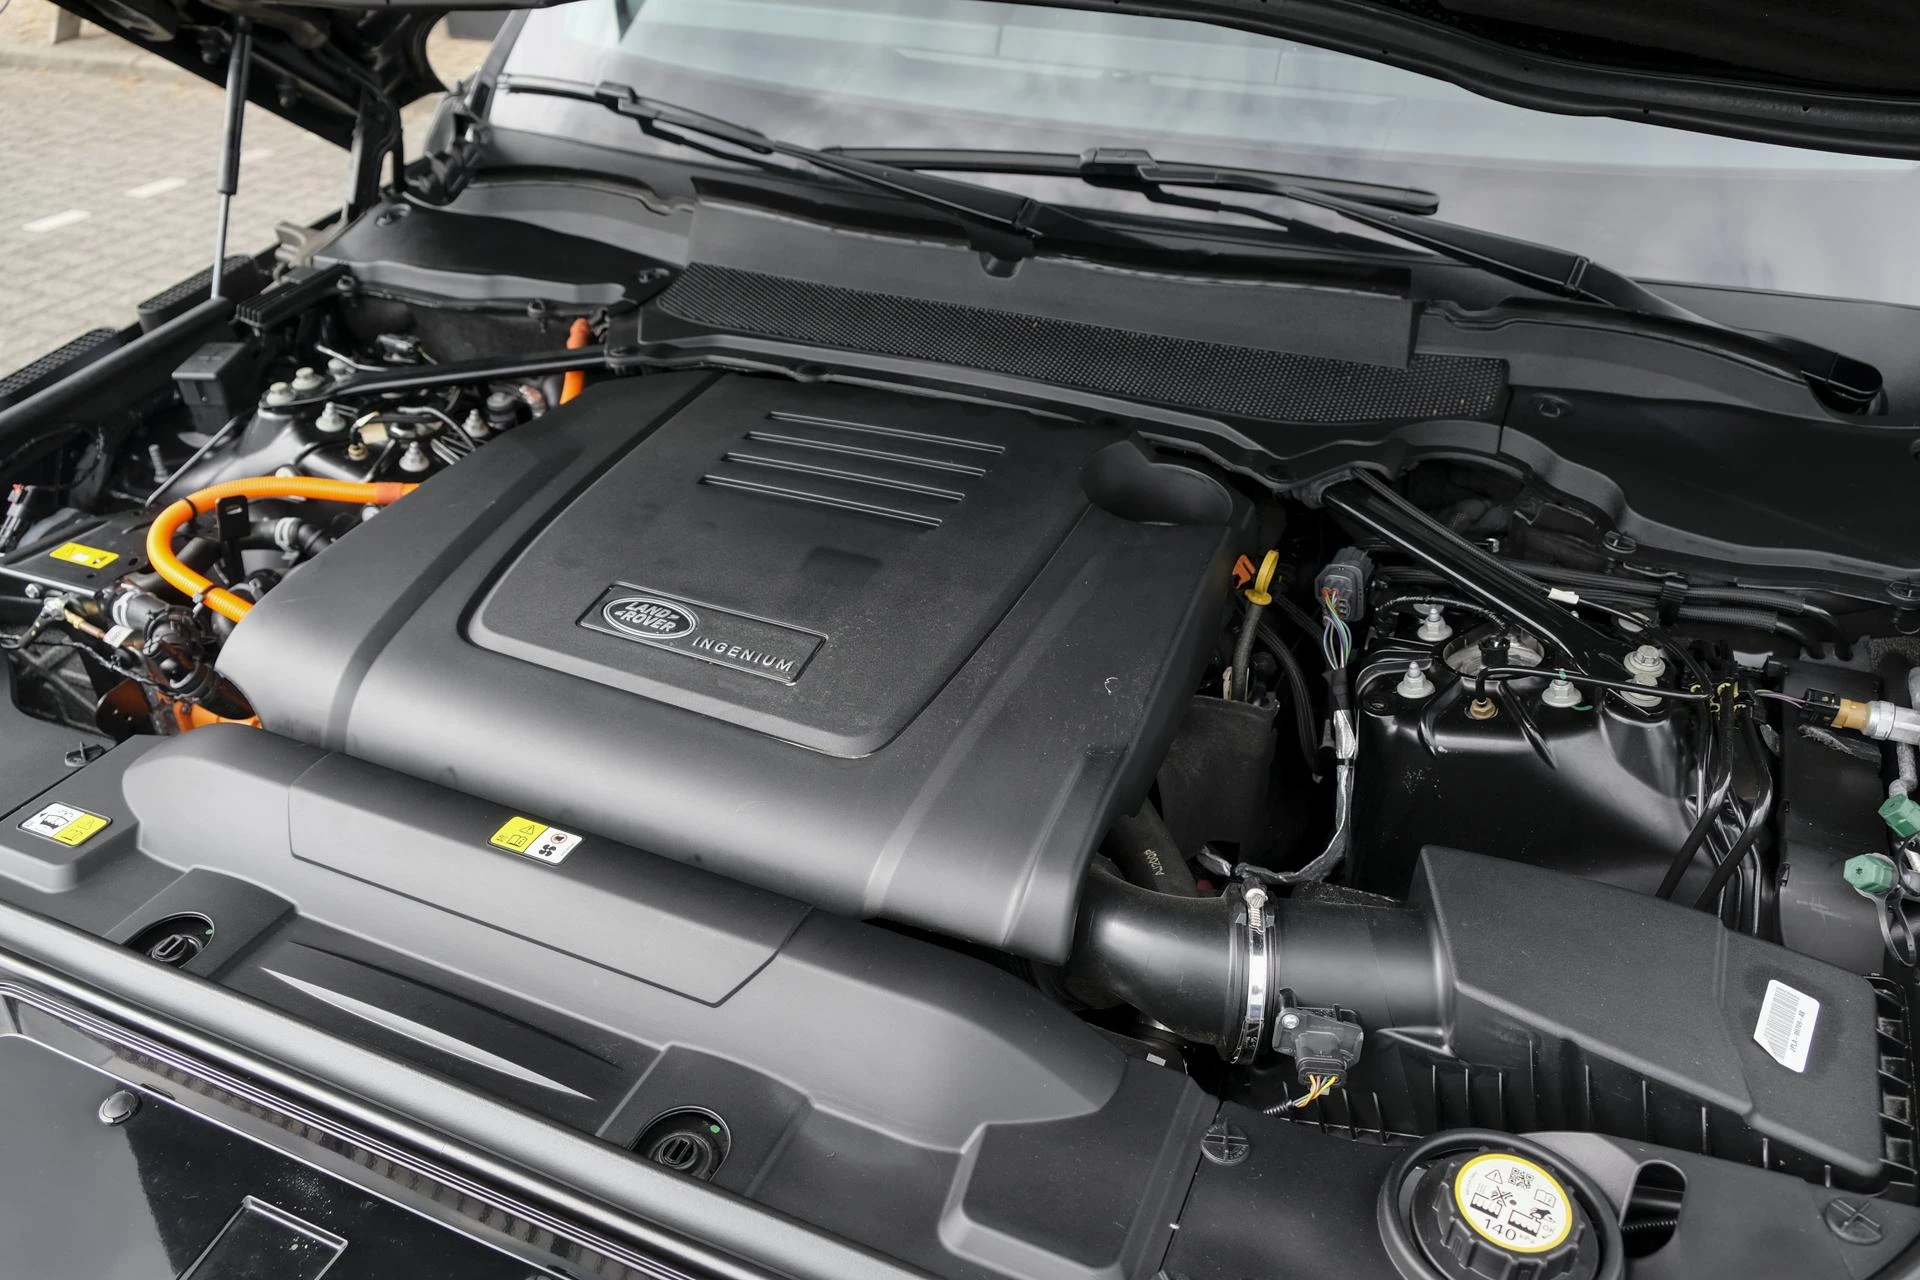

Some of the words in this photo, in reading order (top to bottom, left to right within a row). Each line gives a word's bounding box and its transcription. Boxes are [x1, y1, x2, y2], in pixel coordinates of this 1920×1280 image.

[625, 601, 672, 618] LAND
[620, 611, 676, 632] ROVER
[692, 636, 794, 672] INGENIUM
[1143, 849, 1165, 876] AJ200P
[1485, 1218, 1517, 1241] 140
